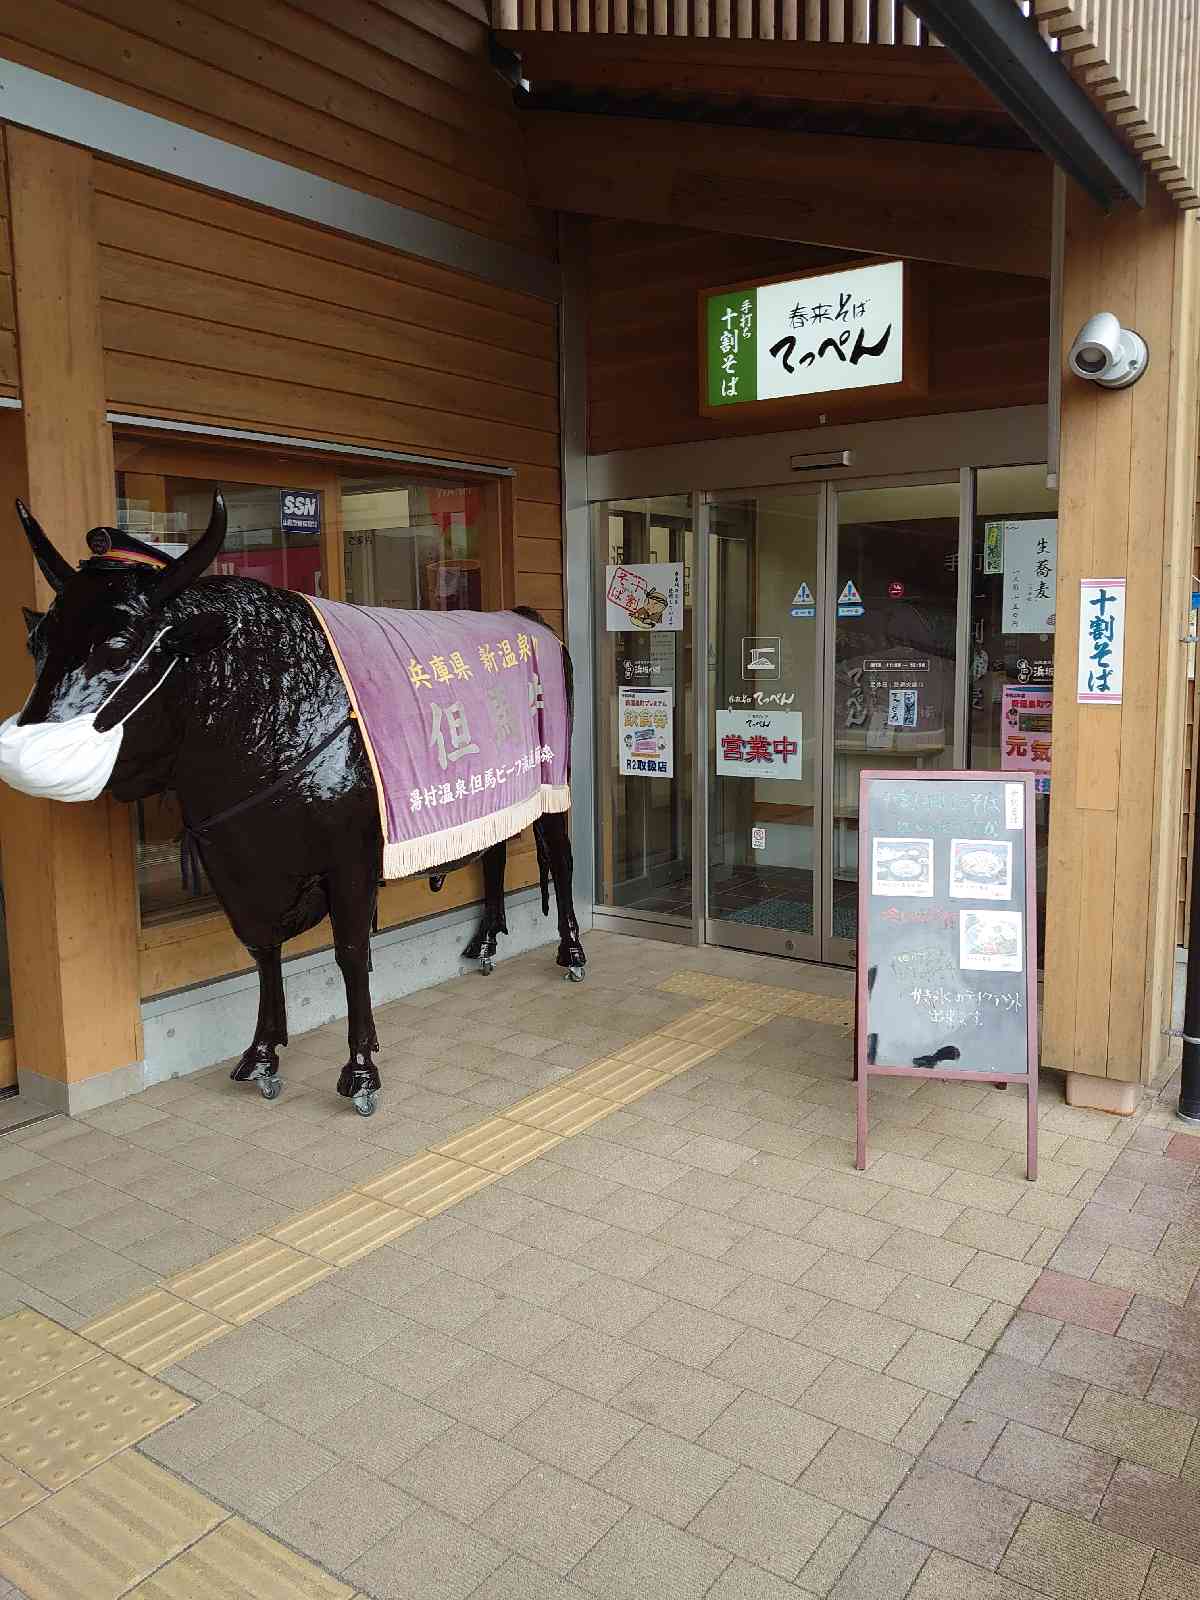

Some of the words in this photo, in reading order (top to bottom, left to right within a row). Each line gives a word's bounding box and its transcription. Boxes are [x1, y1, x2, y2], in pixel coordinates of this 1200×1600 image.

[740, 299, 753, 340] 手打ち
[789, 292, 872, 328] 春来そば
[720, 307, 739, 397] 十割そば
[769, 323, 892, 374] てっぺん
[283, 495, 317, 516] SSN
[1034, 537, 1053, 600] 生蕎麦
[1087, 588, 1118, 692] 十割そば
[409, 650, 475, 689] 兵庫県
[753, 691, 795, 706] てっぺん
[720, 734, 798, 765] 営業中
